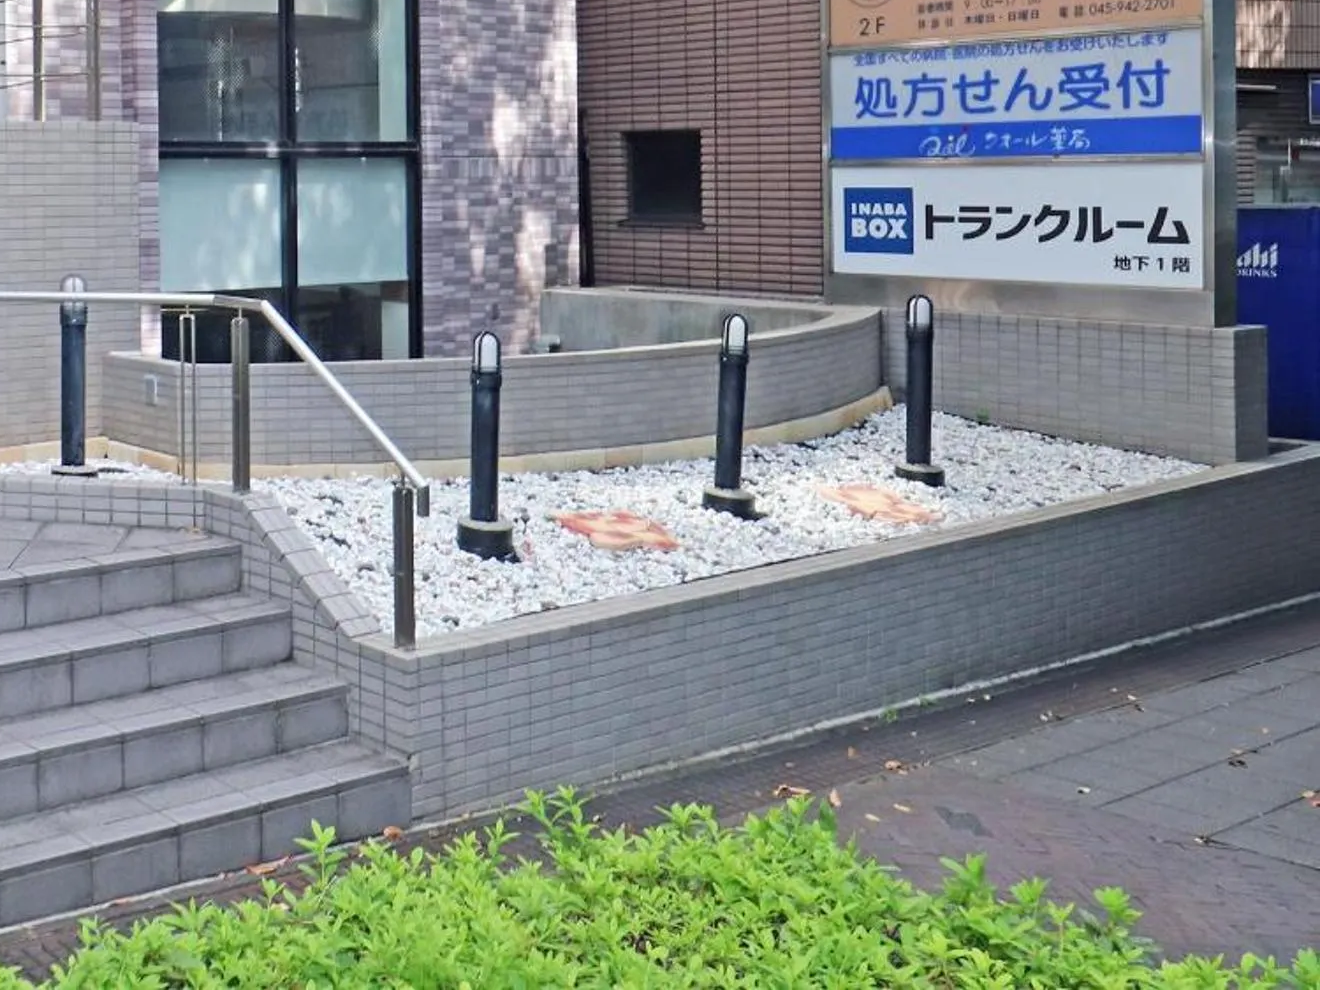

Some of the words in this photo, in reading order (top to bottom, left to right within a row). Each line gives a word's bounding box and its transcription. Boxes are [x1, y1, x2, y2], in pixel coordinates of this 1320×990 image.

[859, 16, 886, 36] 2F
[855, 59, 1171, 119] 処方せん受付
[851, 202, 907, 216] INABA
[851, 216, 908, 241] BOX
[925, 204, 1191, 245] トランクルーム
[1113, 255, 1191, 274] 地下1階
[1236, 242, 1279, 268] ahi
